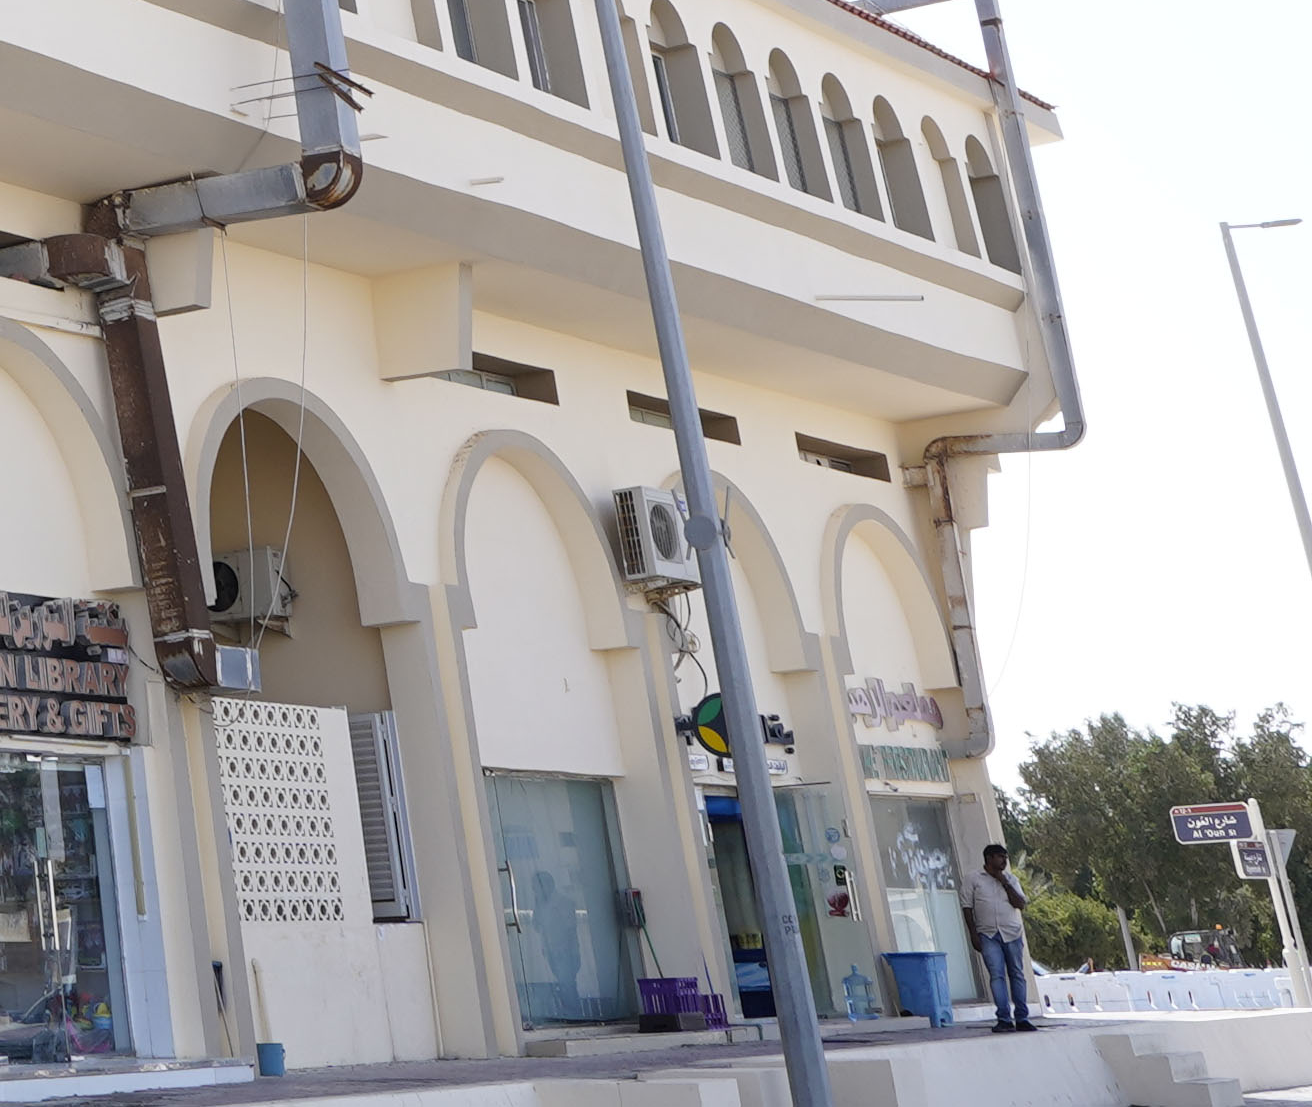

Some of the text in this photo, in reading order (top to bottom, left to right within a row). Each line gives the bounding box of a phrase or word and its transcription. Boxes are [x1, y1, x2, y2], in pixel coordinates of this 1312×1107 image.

[23, 654, 129, 696] LIBRARY
[40, 697, 66, 733] &
[65, 700, 136, 738] GIFTS
[1192, 830, 1203, 839] Al
[1214, 815, 1238, 829] شارع
